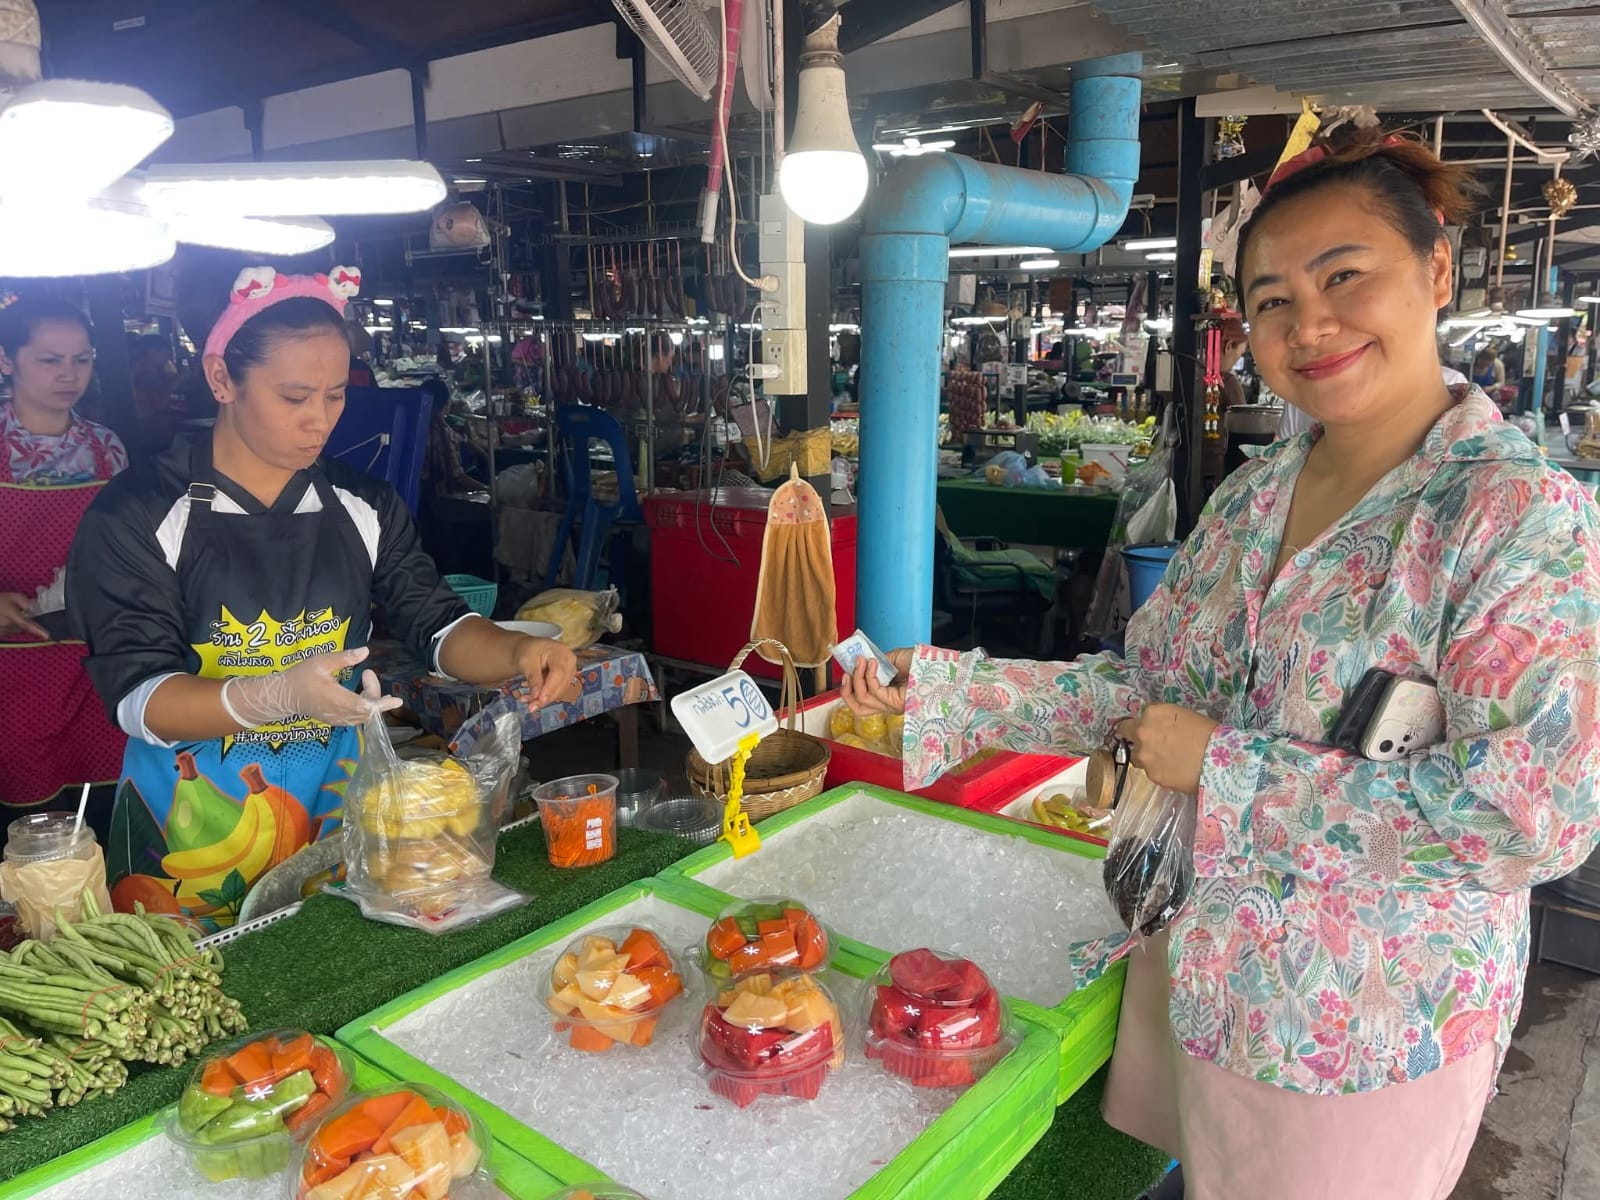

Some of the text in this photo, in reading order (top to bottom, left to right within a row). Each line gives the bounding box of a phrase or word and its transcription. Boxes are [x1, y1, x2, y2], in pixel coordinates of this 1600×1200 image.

[211, 621, 243, 647] ร้าน
[246, 622, 270, 648] 2
[721, 679, 767, 728] 50
